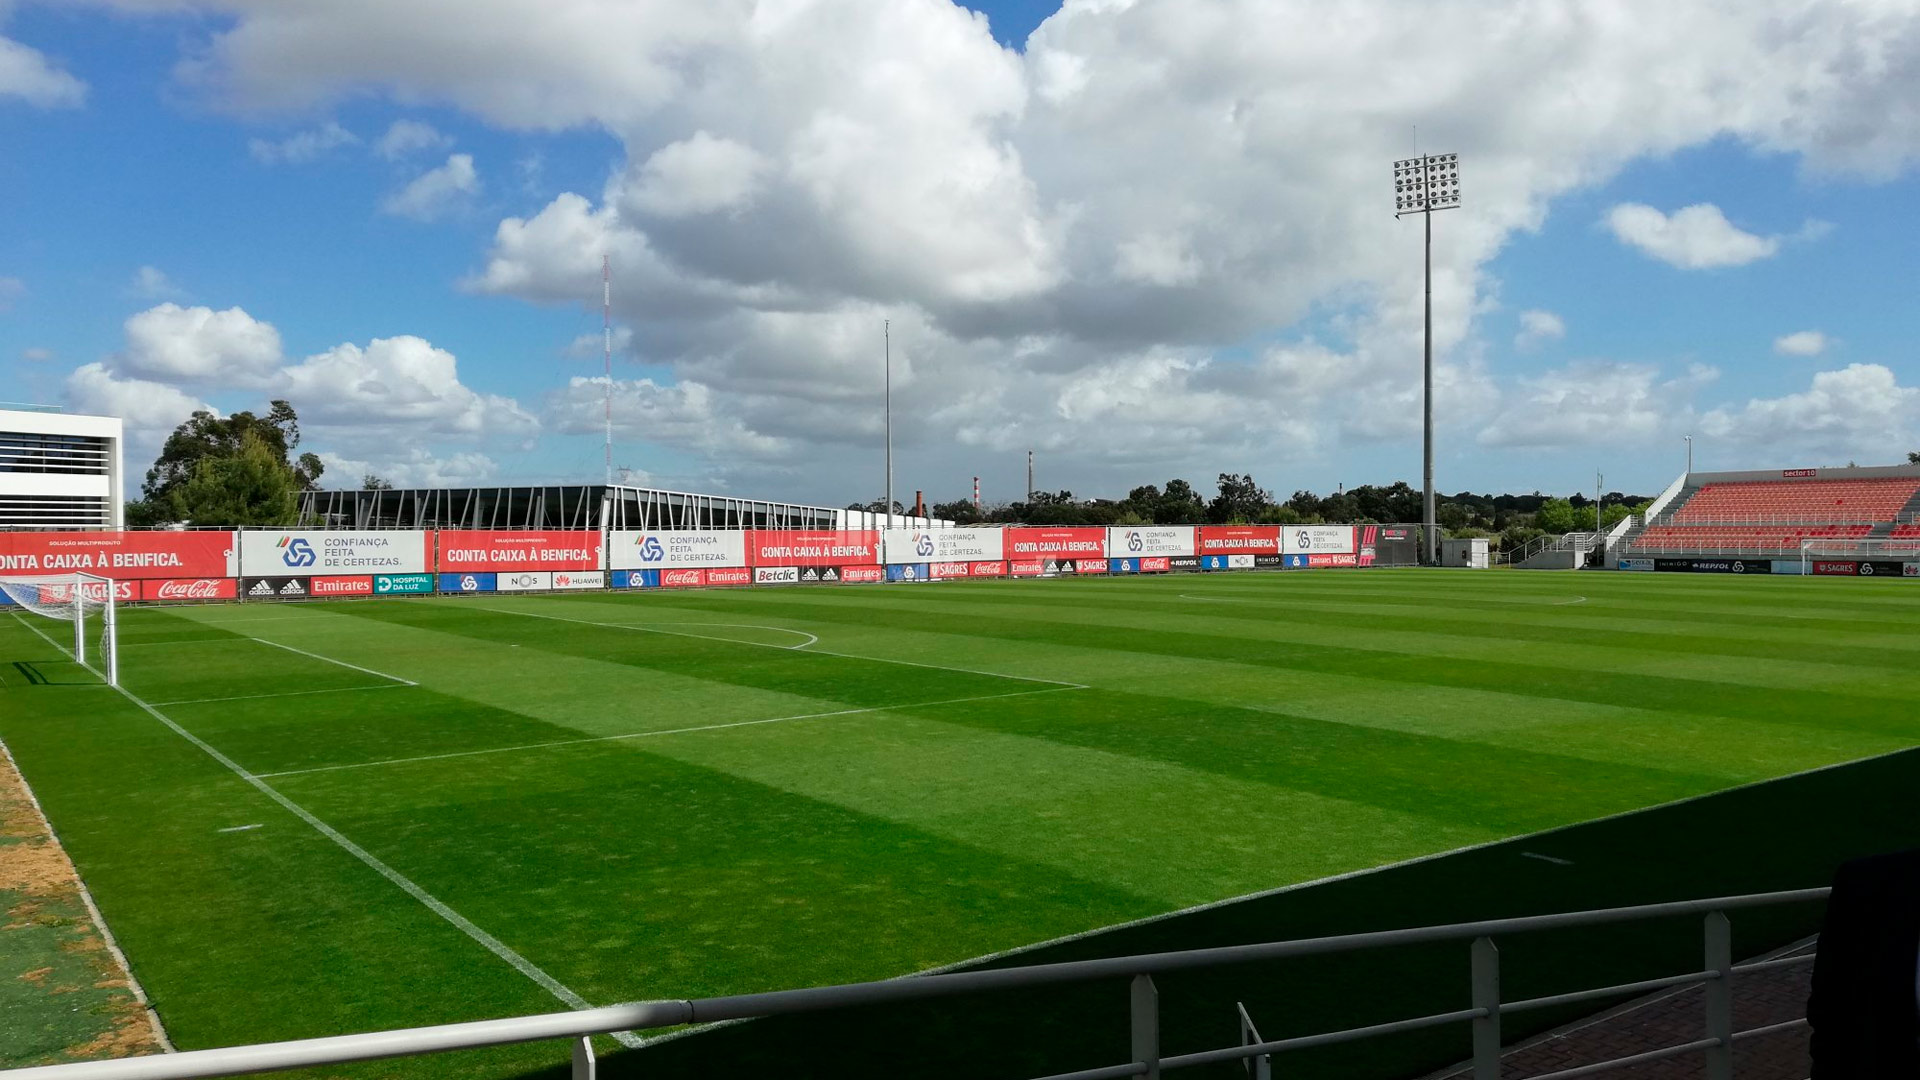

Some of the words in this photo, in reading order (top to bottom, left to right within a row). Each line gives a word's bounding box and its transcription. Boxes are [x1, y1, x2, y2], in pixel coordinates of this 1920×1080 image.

[324, 538, 389, 549] CONFIANÇA
[669, 536, 718, 546] CONFIANÇA
[670, 545, 692, 553] FEITA
[761, 547, 792, 557] CONTA
[793, 547, 821, 557] CAIXA
[823, 544, 830, 557] À
[832, 546, 871, 556] BENFICA.
[1014, 542, 1038, 552] CONTA
[324, 548, 355, 557] FEITA
[447, 549, 488, 562] CONTA
[490, 549, 526, 562] CAIXA
[529, 547, 539, 561] À
[541, 549, 591, 561] BENFICA.
[684, 553, 728, 561] CERTEZAS.
[43, 554, 93, 569] CAIXA
[97, 550, 109, 568] À
[113, 552, 183, 567] BENFICA.
[325, 559, 341, 567] DE
[343, 558, 402, 567] CERTEZAS.
[844, 568, 880, 578] Emirates
[940, 564, 968, 575] SAGRES
[1827, 564, 1853, 572] SAGRES
[665, 571, 700, 584] Coca-Cola
[709, 572, 749, 582] Emirates
[758, 569, 795, 580] Betclic
[314, 580, 370, 592] Emirates
[512, 574, 537, 588] NOS
[158, 580, 220, 598] Coca-Cola
[280, 587, 304, 595] adidas
